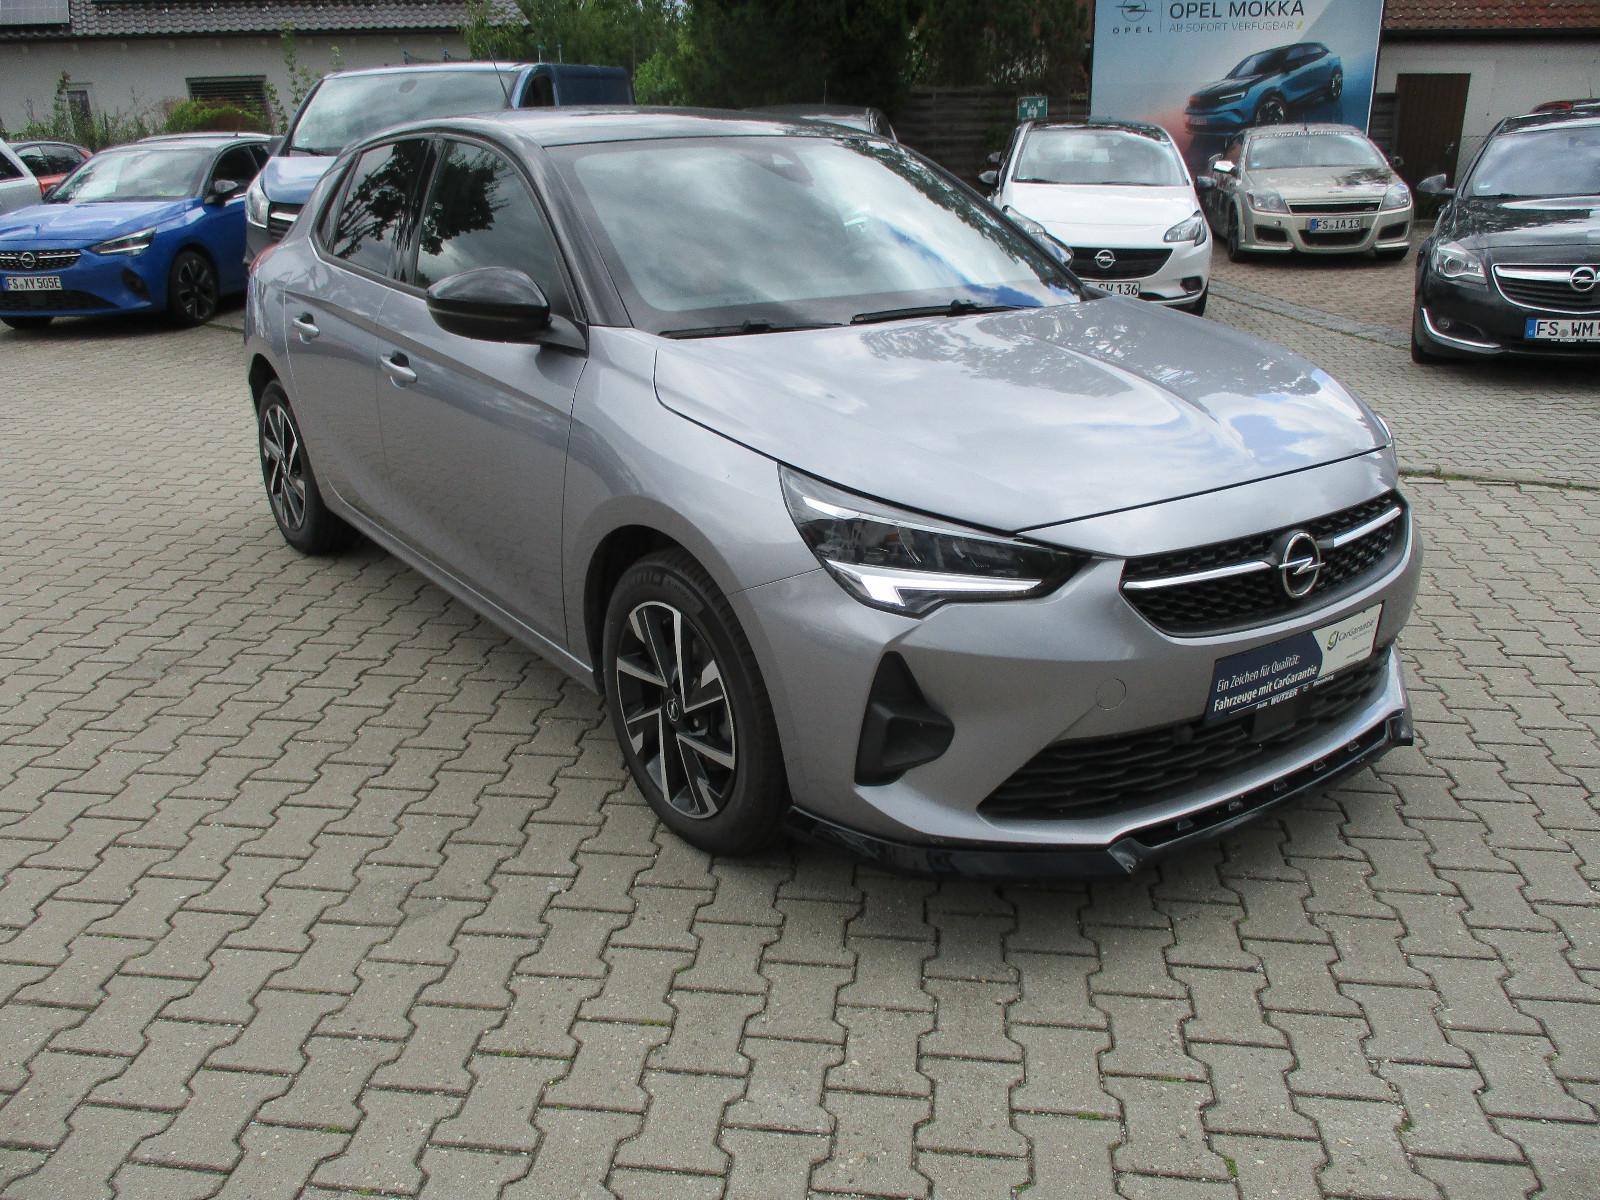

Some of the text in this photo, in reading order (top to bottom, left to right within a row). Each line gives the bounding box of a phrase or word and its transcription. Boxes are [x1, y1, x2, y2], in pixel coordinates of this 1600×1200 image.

[1169, 0, 1305, 19] OPEL MOKKA
[1112, 26, 1153, 34] OPEL
[1169, 23, 1183, 33] AB
[1185, 22, 1228, 33] SOFORT
[1116, 283, 1138, 296] 136
[1536, 321, 1594, 336] FS WM
[1216, 679, 1229, 693] Ein
[1229, 669, 1260, 689] Zeichen
[1259, 663, 1272, 678] für
[1213, 664, 1318, 713] Fahrzeuge mit CarGarantie
